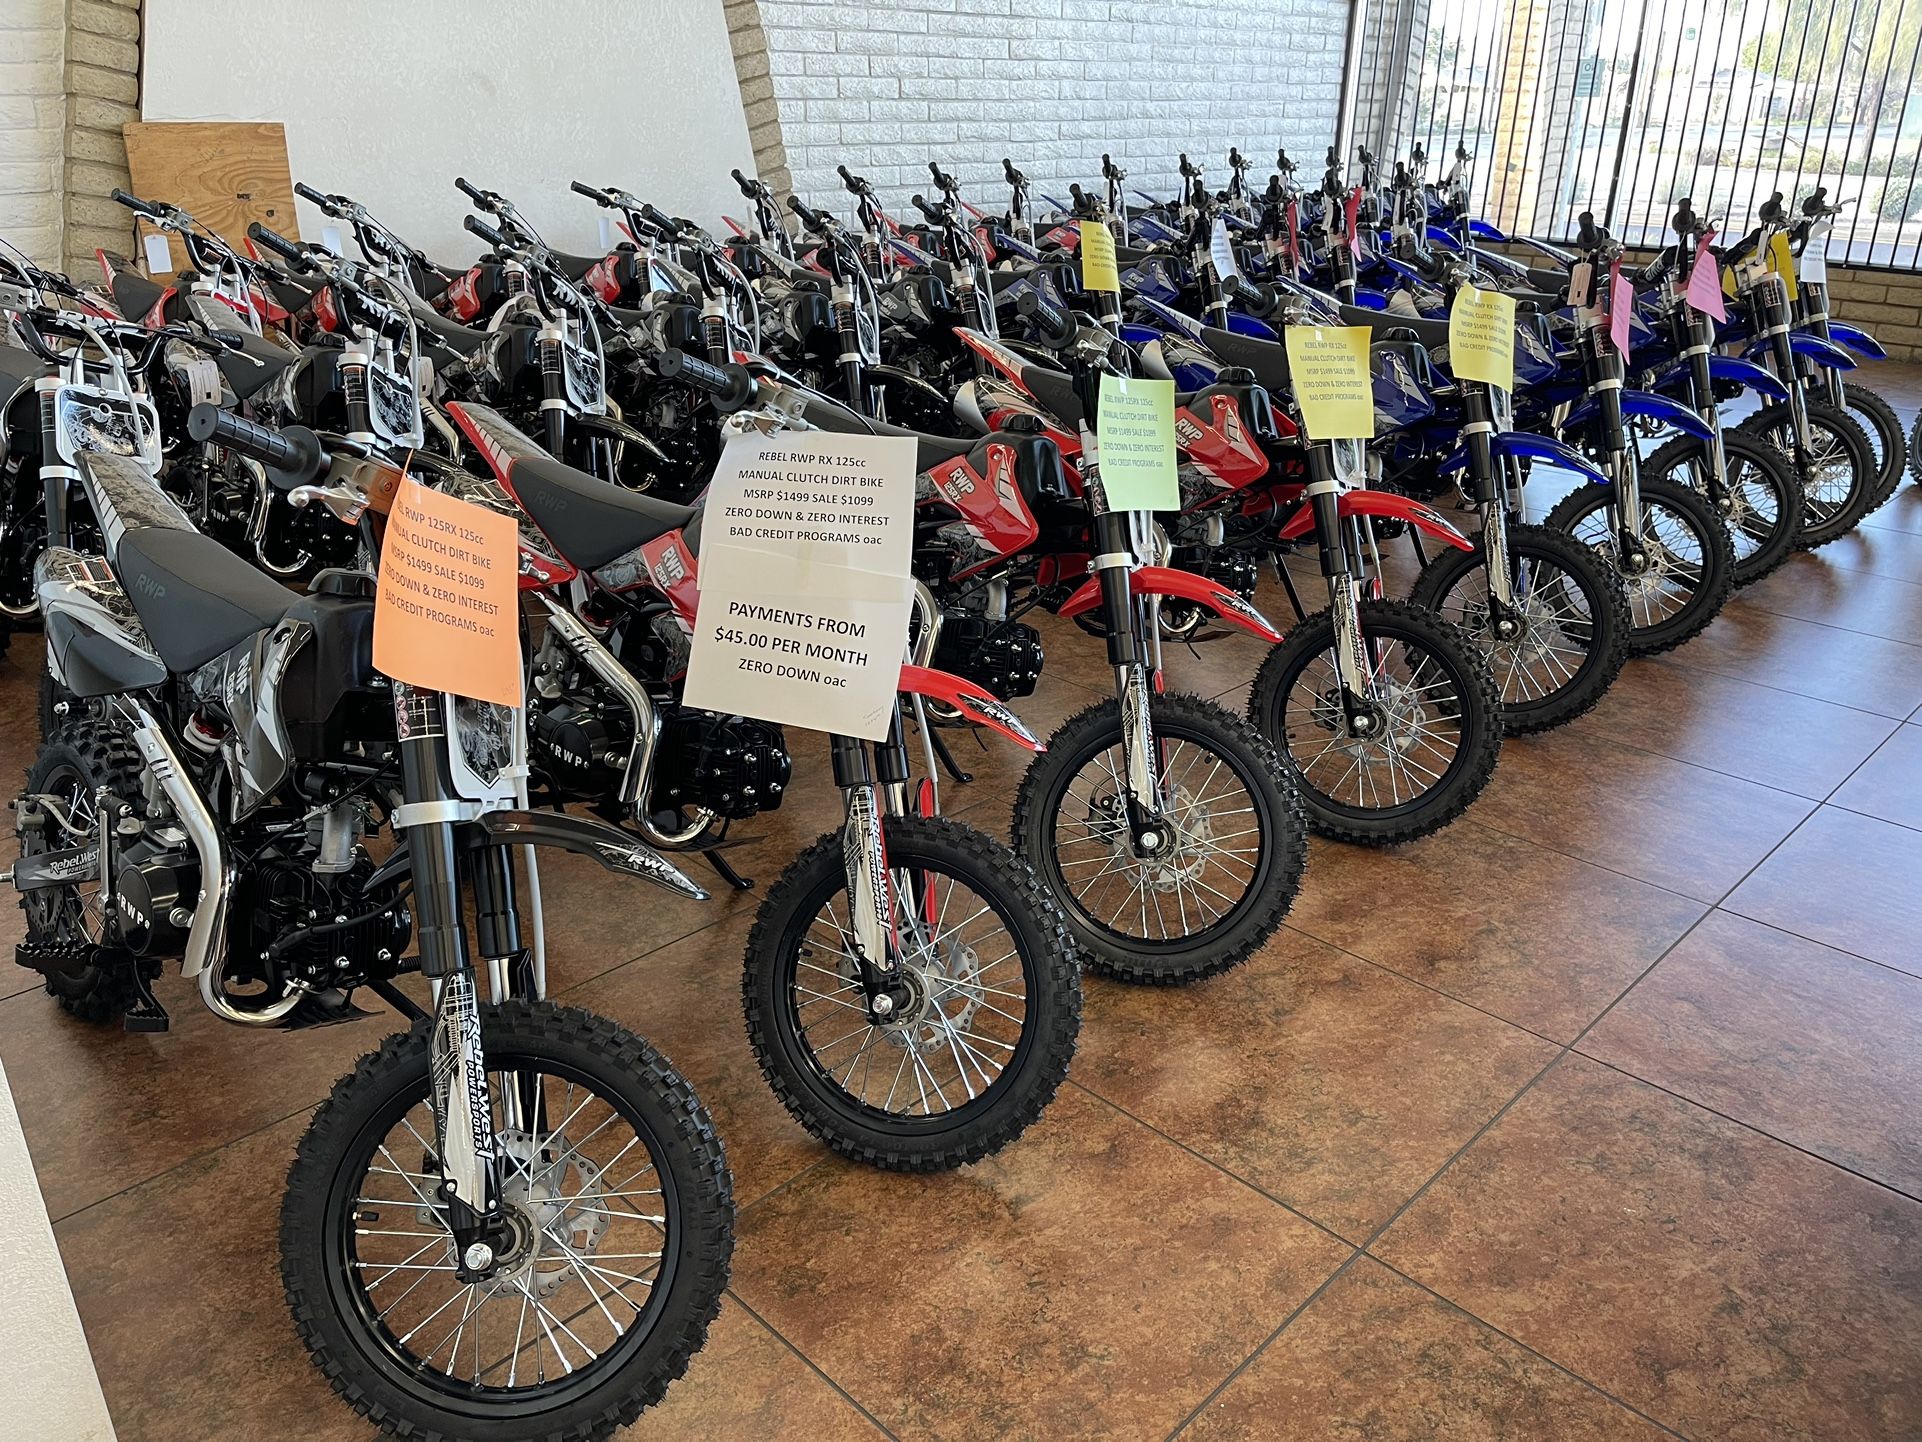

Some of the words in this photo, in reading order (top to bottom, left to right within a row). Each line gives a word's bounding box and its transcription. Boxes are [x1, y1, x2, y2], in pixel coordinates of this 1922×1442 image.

[1115, 396, 1124, 404] RWP
[1120, 412, 1136, 421] CLUTCH
[1137, 413, 1147, 421] DIRT
[1148, 414, 1158, 422] BIKE
[1175, 418, 1203, 440] RWP
[1132, 428, 1142, 436] SALE
[759, 452, 787, 462] REBEL
[790, 454, 815, 464] RWP
[819, 456, 832, 465] RX
[836, 457, 866, 467] 125cc
[1104, 442, 1114, 450] ZERO
[1115, 443, 1128, 451] DOWN
[1133, 444, 1144, 452] ZERO
[1145, 444, 1164, 452] INTEREST
[1132, 459, 1155, 467] PROGRAMS
[738, 470, 784, 481] MANUAL
[787, 472, 828, 484] CLUTCH
[832, 476, 857, 485] DIRT
[860, 478, 884, 487] BIKE
[949, 467, 975, 494] RWP
[744, 489, 773, 499] MSRP
[776, 490, 809, 503] $1499
[812, 493, 838, 504] SALE
[841, 495, 874, 506] $1099
[405, 507, 425, 524] RWP
[428, 517, 457, 536] 125RX
[459, 527, 484, 545] 125cc
[725, 507, 752, 518] ZERO
[755, 508, 792, 521] DOWN
[796, 512, 804, 521] &
[807, 512, 836, 523] ZERO
[839, 514, 890, 526] INTEREST
[730, 526, 752, 537] BAD
[755, 528, 794, 540] CREDIT
[797, 531, 860, 544] PROGRAMS
[863, 536, 882, 545] oac
[411, 534, 446, 555] CLUTCH
[449, 546, 470, 564] DIRT
[472, 554, 491, 569] BIKE
[661, 545, 685, 582] RWP
[406, 554, 432, 574] $1499
[435, 565, 456, 581] SALE
[458, 574, 485, 589] $1099
[653, 562, 672, 590] 125RX
[134, 573, 166, 600] RWP
[395, 572, 420, 593] DOWN
[423, 584, 430, 596] &
[432, 587, 456, 604] ZERO
[458, 595, 498, 616] INTEREST
[397, 598, 423, 618] CREDIT
[426, 610, 477, 633] PROGRAMS
[479, 625, 495, 637] oac
[729, 601, 813, 628] PAYMENTS
[817, 617, 866, 638] FROM
[715, 626, 767, 648] $45.00
[772, 637, 800, 654] PER
[805, 643, 868, 666] MONTH
[235, 651, 251, 695] RWP
[738, 658, 773, 674] ZERO
[776, 664, 820, 683] DOWN
[824, 676, 847, 688] oac
[554, 744, 582, 767] RWP
[627, 853, 675, 874] RWP
[119, 895, 144, 926] RWP
[465, 1058, 484, 1153] POWERSPORTS
